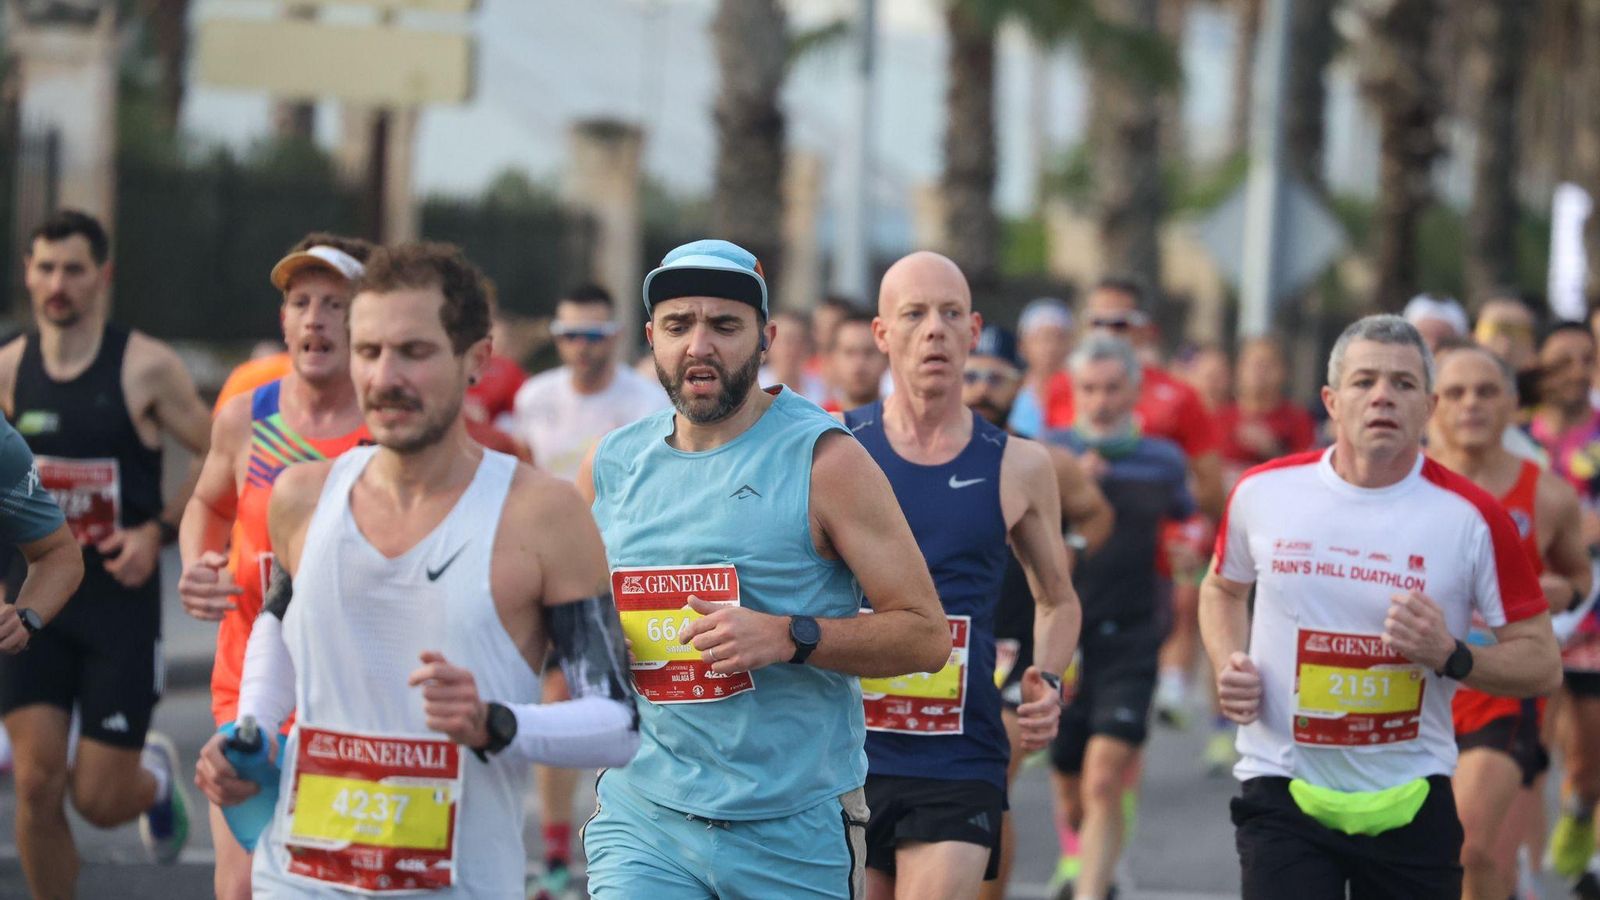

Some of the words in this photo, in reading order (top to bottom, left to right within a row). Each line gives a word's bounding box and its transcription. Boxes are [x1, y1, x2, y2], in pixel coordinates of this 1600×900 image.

[645, 573, 730, 593] GENERALI
[1272, 559, 1311, 574] PAIN'S
[1316, 563, 1345, 578] HILL
[1350, 566, 1425, 592] DUATHLON
[647, 617, 690, 642] 664
[1328, 674, 1390, 697] 2151
[338, 737, 448, 769] GENERALI
[331, 788, 411, 824] 4237
